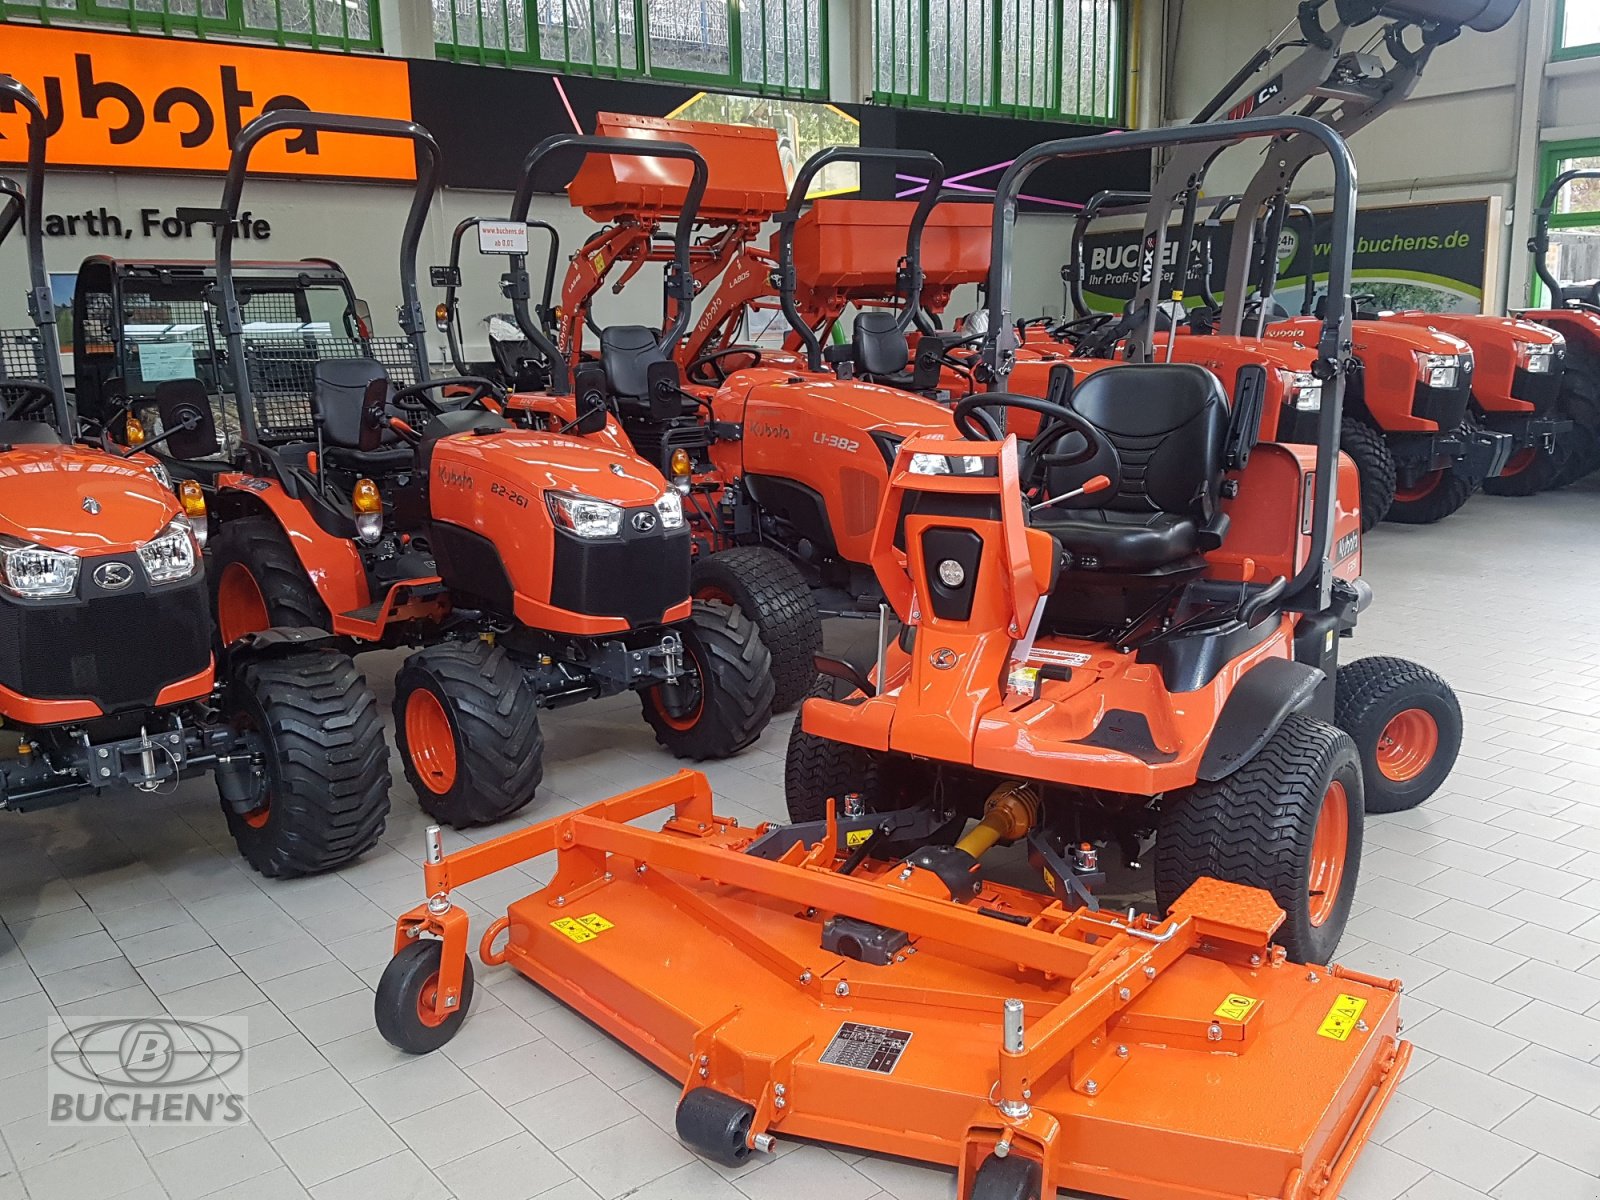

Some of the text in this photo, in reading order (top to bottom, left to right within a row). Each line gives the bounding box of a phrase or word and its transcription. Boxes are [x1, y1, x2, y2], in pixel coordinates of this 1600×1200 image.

[482, 227, 525, 235] www.buchens.de
[1141, 249, 1155, 283] MX
[1089, 274, 1101, 285] Ihr
[698, 297, 722, 332] Kubota
[750, 421, 790, 440] Kubota
[438, 465, 474, 490] Kubota
[490, 482, 529, 509] B2-261
